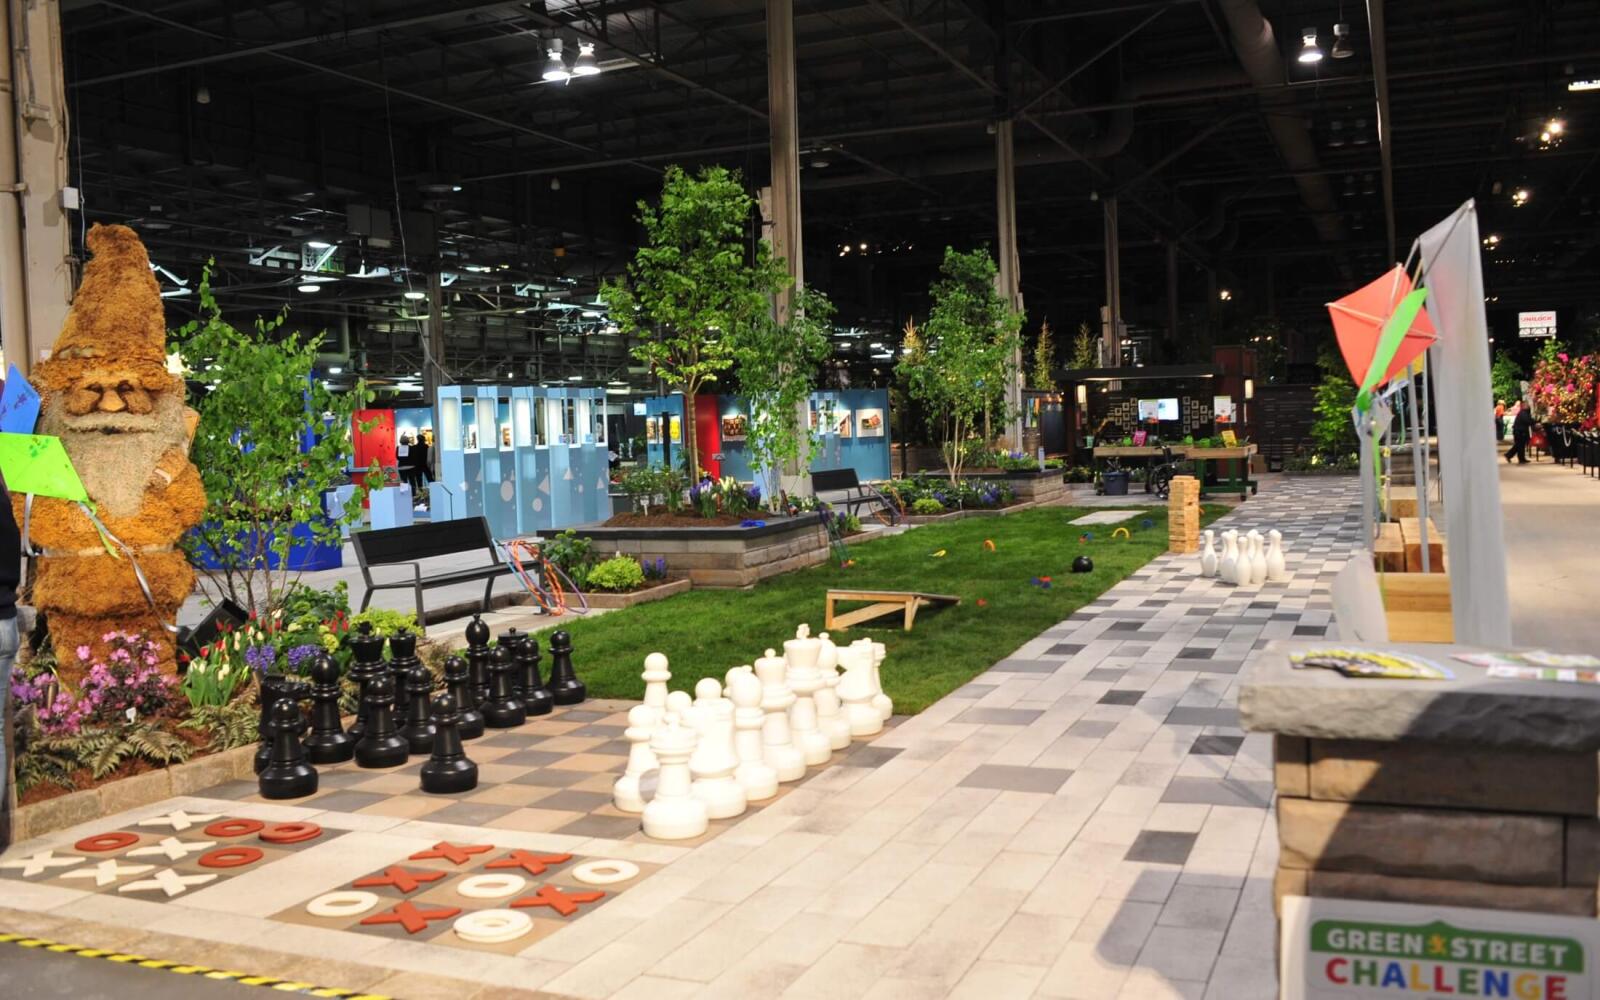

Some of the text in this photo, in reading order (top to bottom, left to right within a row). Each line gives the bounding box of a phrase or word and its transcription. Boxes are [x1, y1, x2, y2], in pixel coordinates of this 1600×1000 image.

[1327, 928, 1568, 966] GREEN STREET
[1325, 957, 1567, 1000] CHALLENGE
